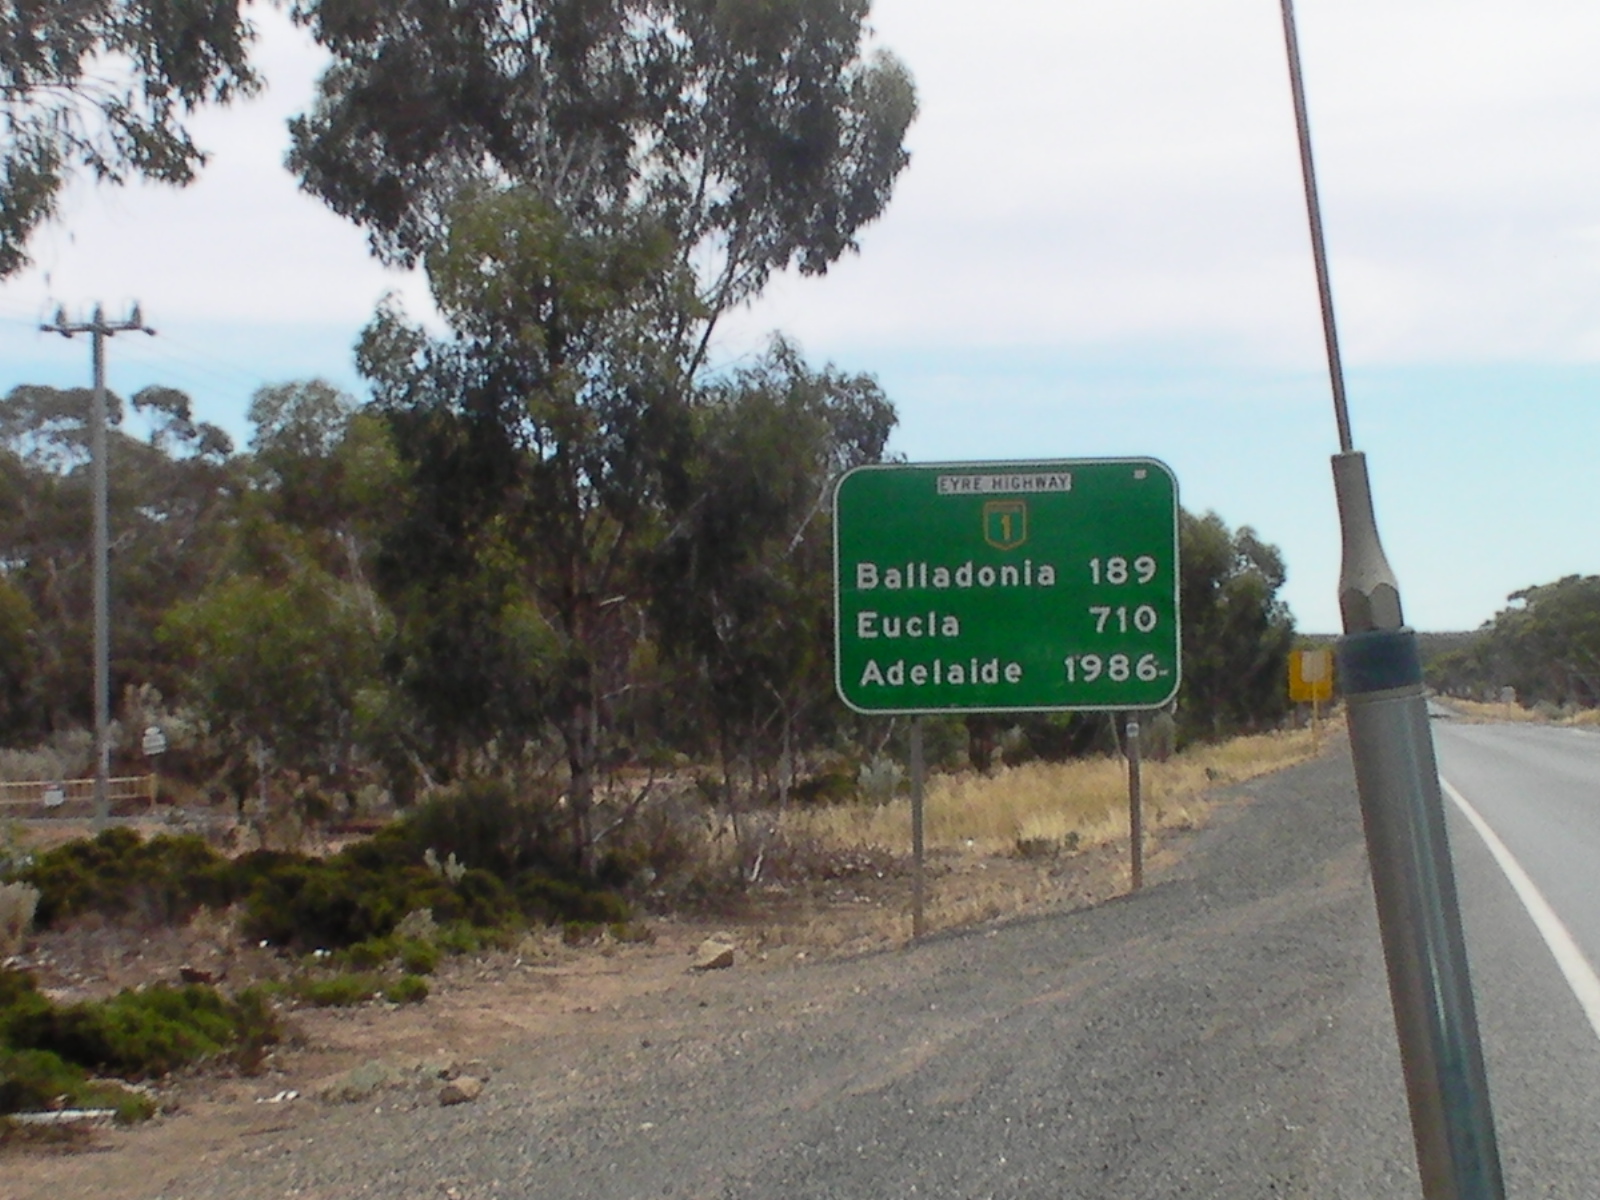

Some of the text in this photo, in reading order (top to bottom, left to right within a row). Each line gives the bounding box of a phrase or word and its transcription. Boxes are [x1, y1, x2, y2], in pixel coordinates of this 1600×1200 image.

[940, 475, 1068, 491] EYRE HIGHWAY
[1001, 514, 1011, 541] 1
[856, 556, 1157, 589] Balladonia 189
[857, 605, 1157, 638] Eucla 710
[859, 653, 1158, 687] Adelaide 1986
